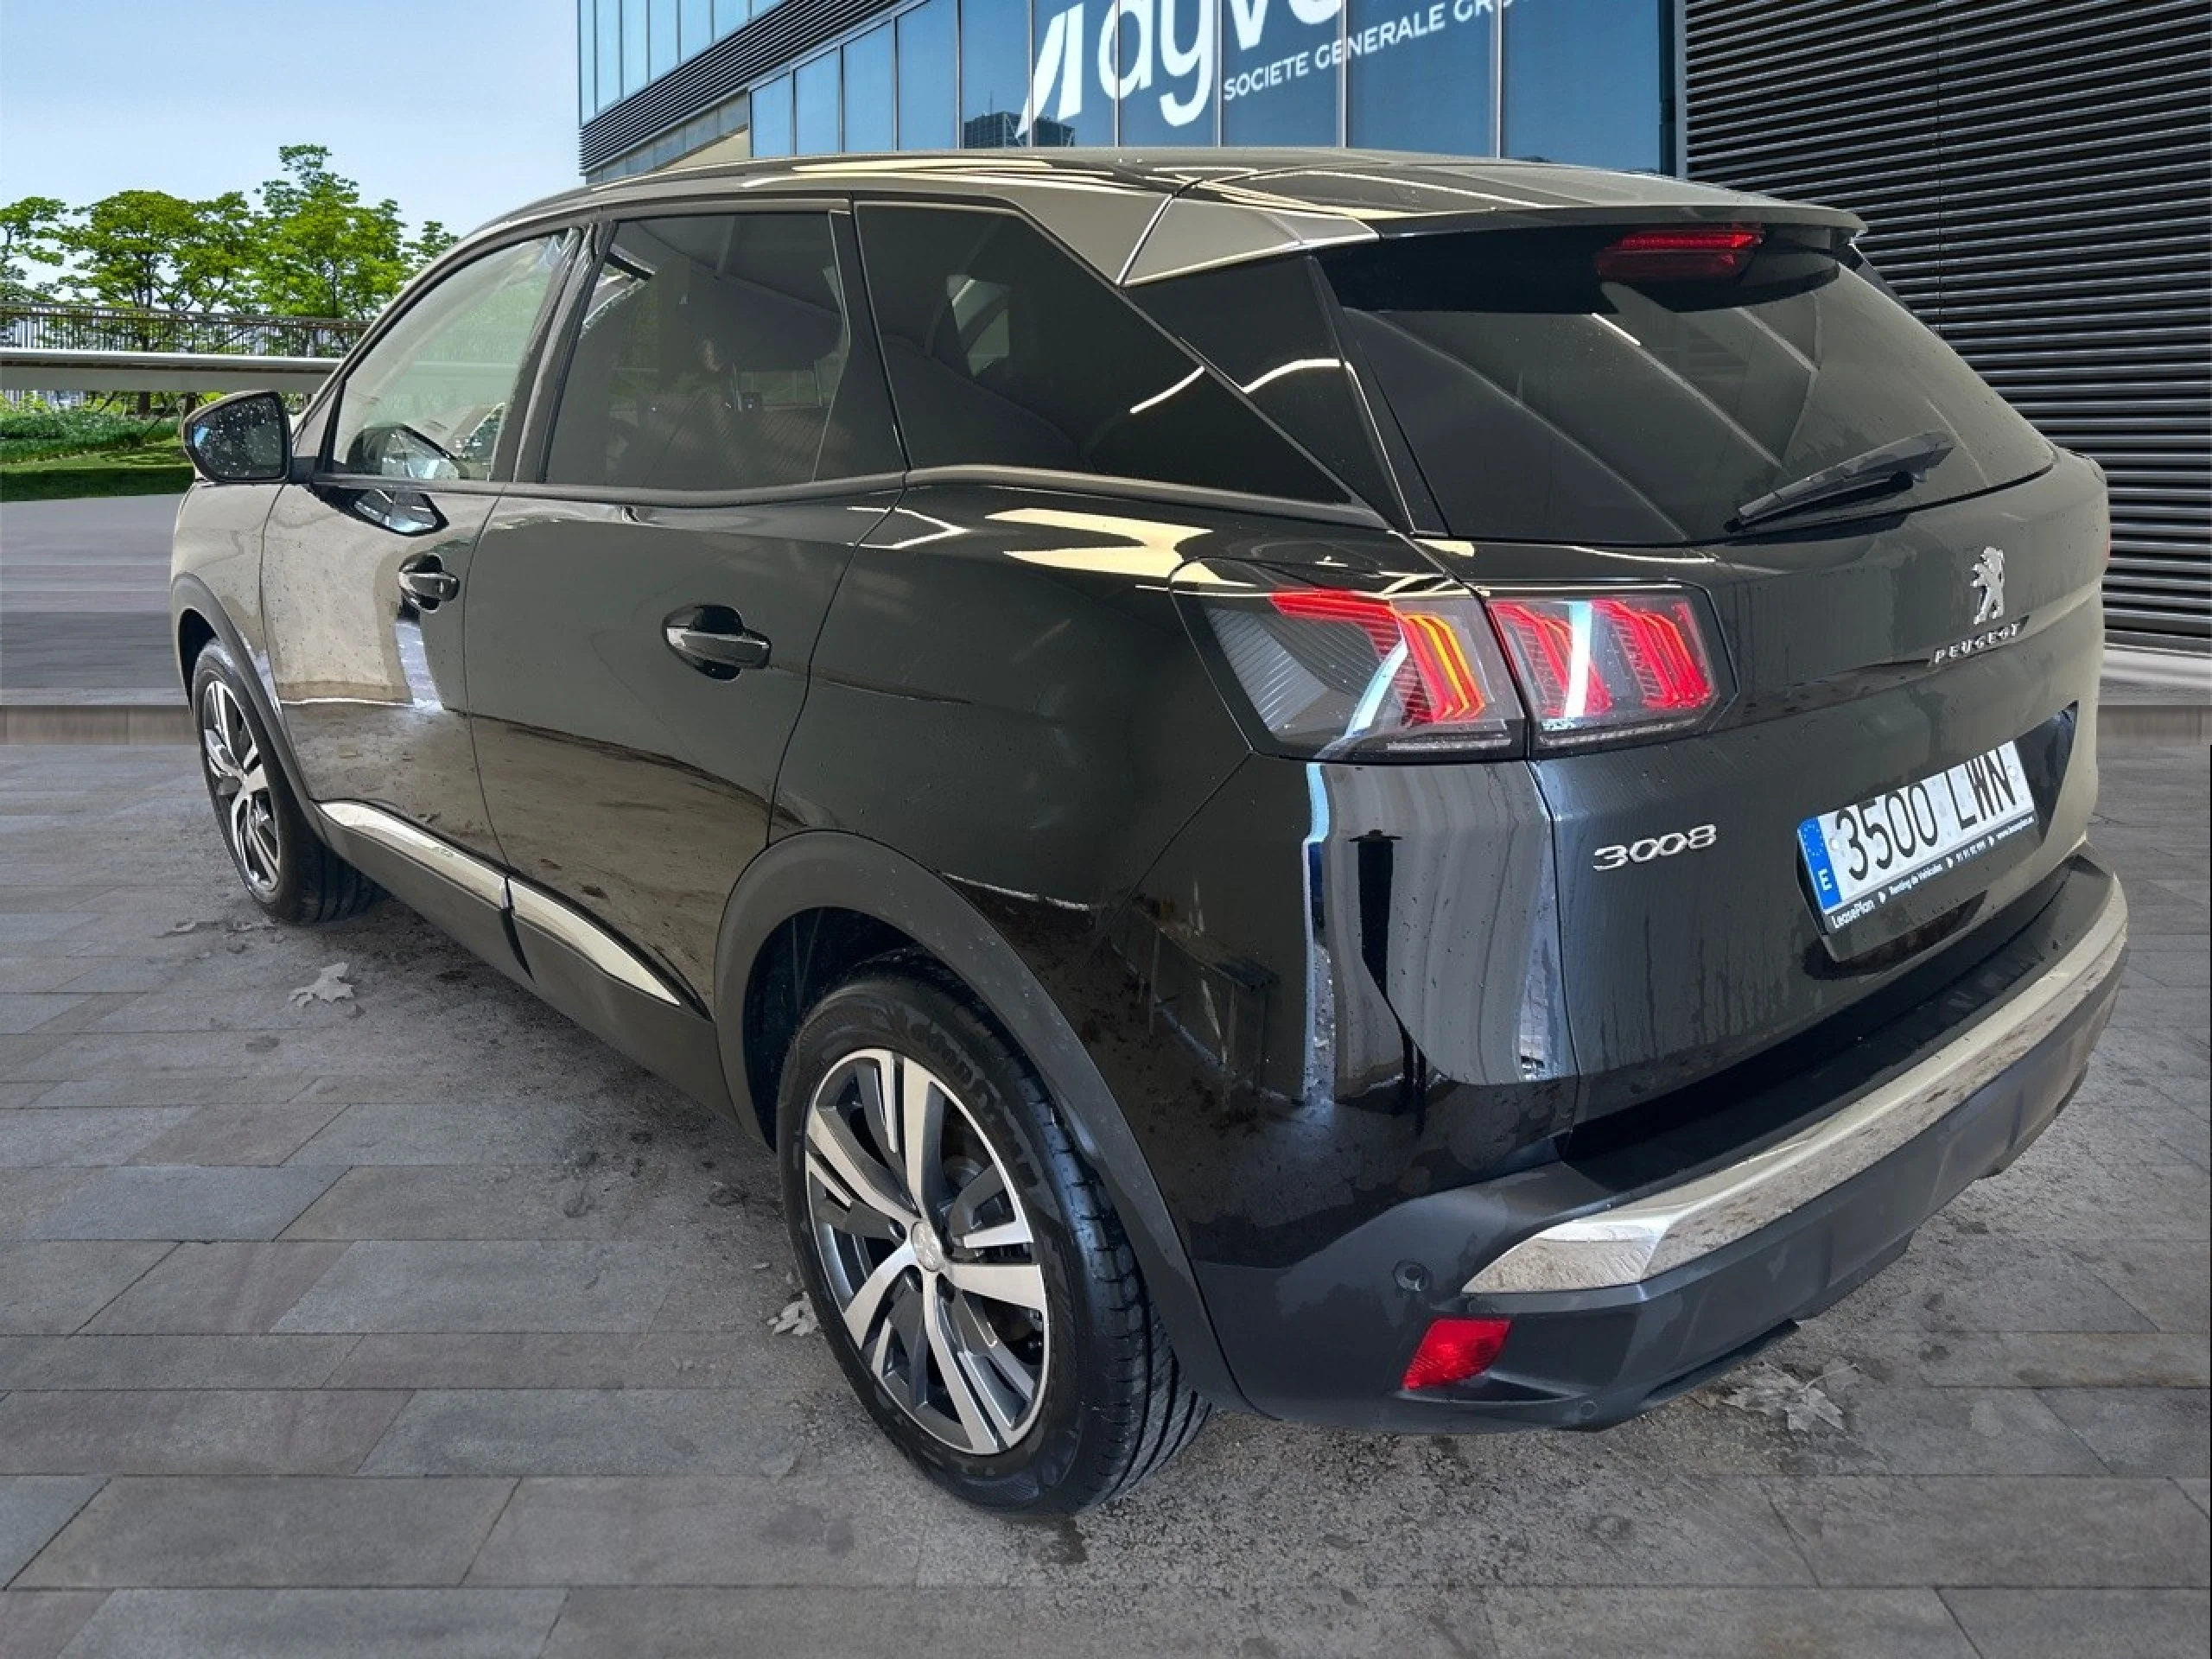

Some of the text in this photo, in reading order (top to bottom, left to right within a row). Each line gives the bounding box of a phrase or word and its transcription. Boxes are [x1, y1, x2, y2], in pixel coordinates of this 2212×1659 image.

[1224, 51, 1309, 101] SOCIETE
[1314, 3, 1446, 69] GENERALE
[1934, 623, 2021, 664] PEUGEOT
[1835, 747, 2017, 880] 3500 LWN
[1592, 823, 1717, 872] 3008
[1817, 868, 1833, 892] E
